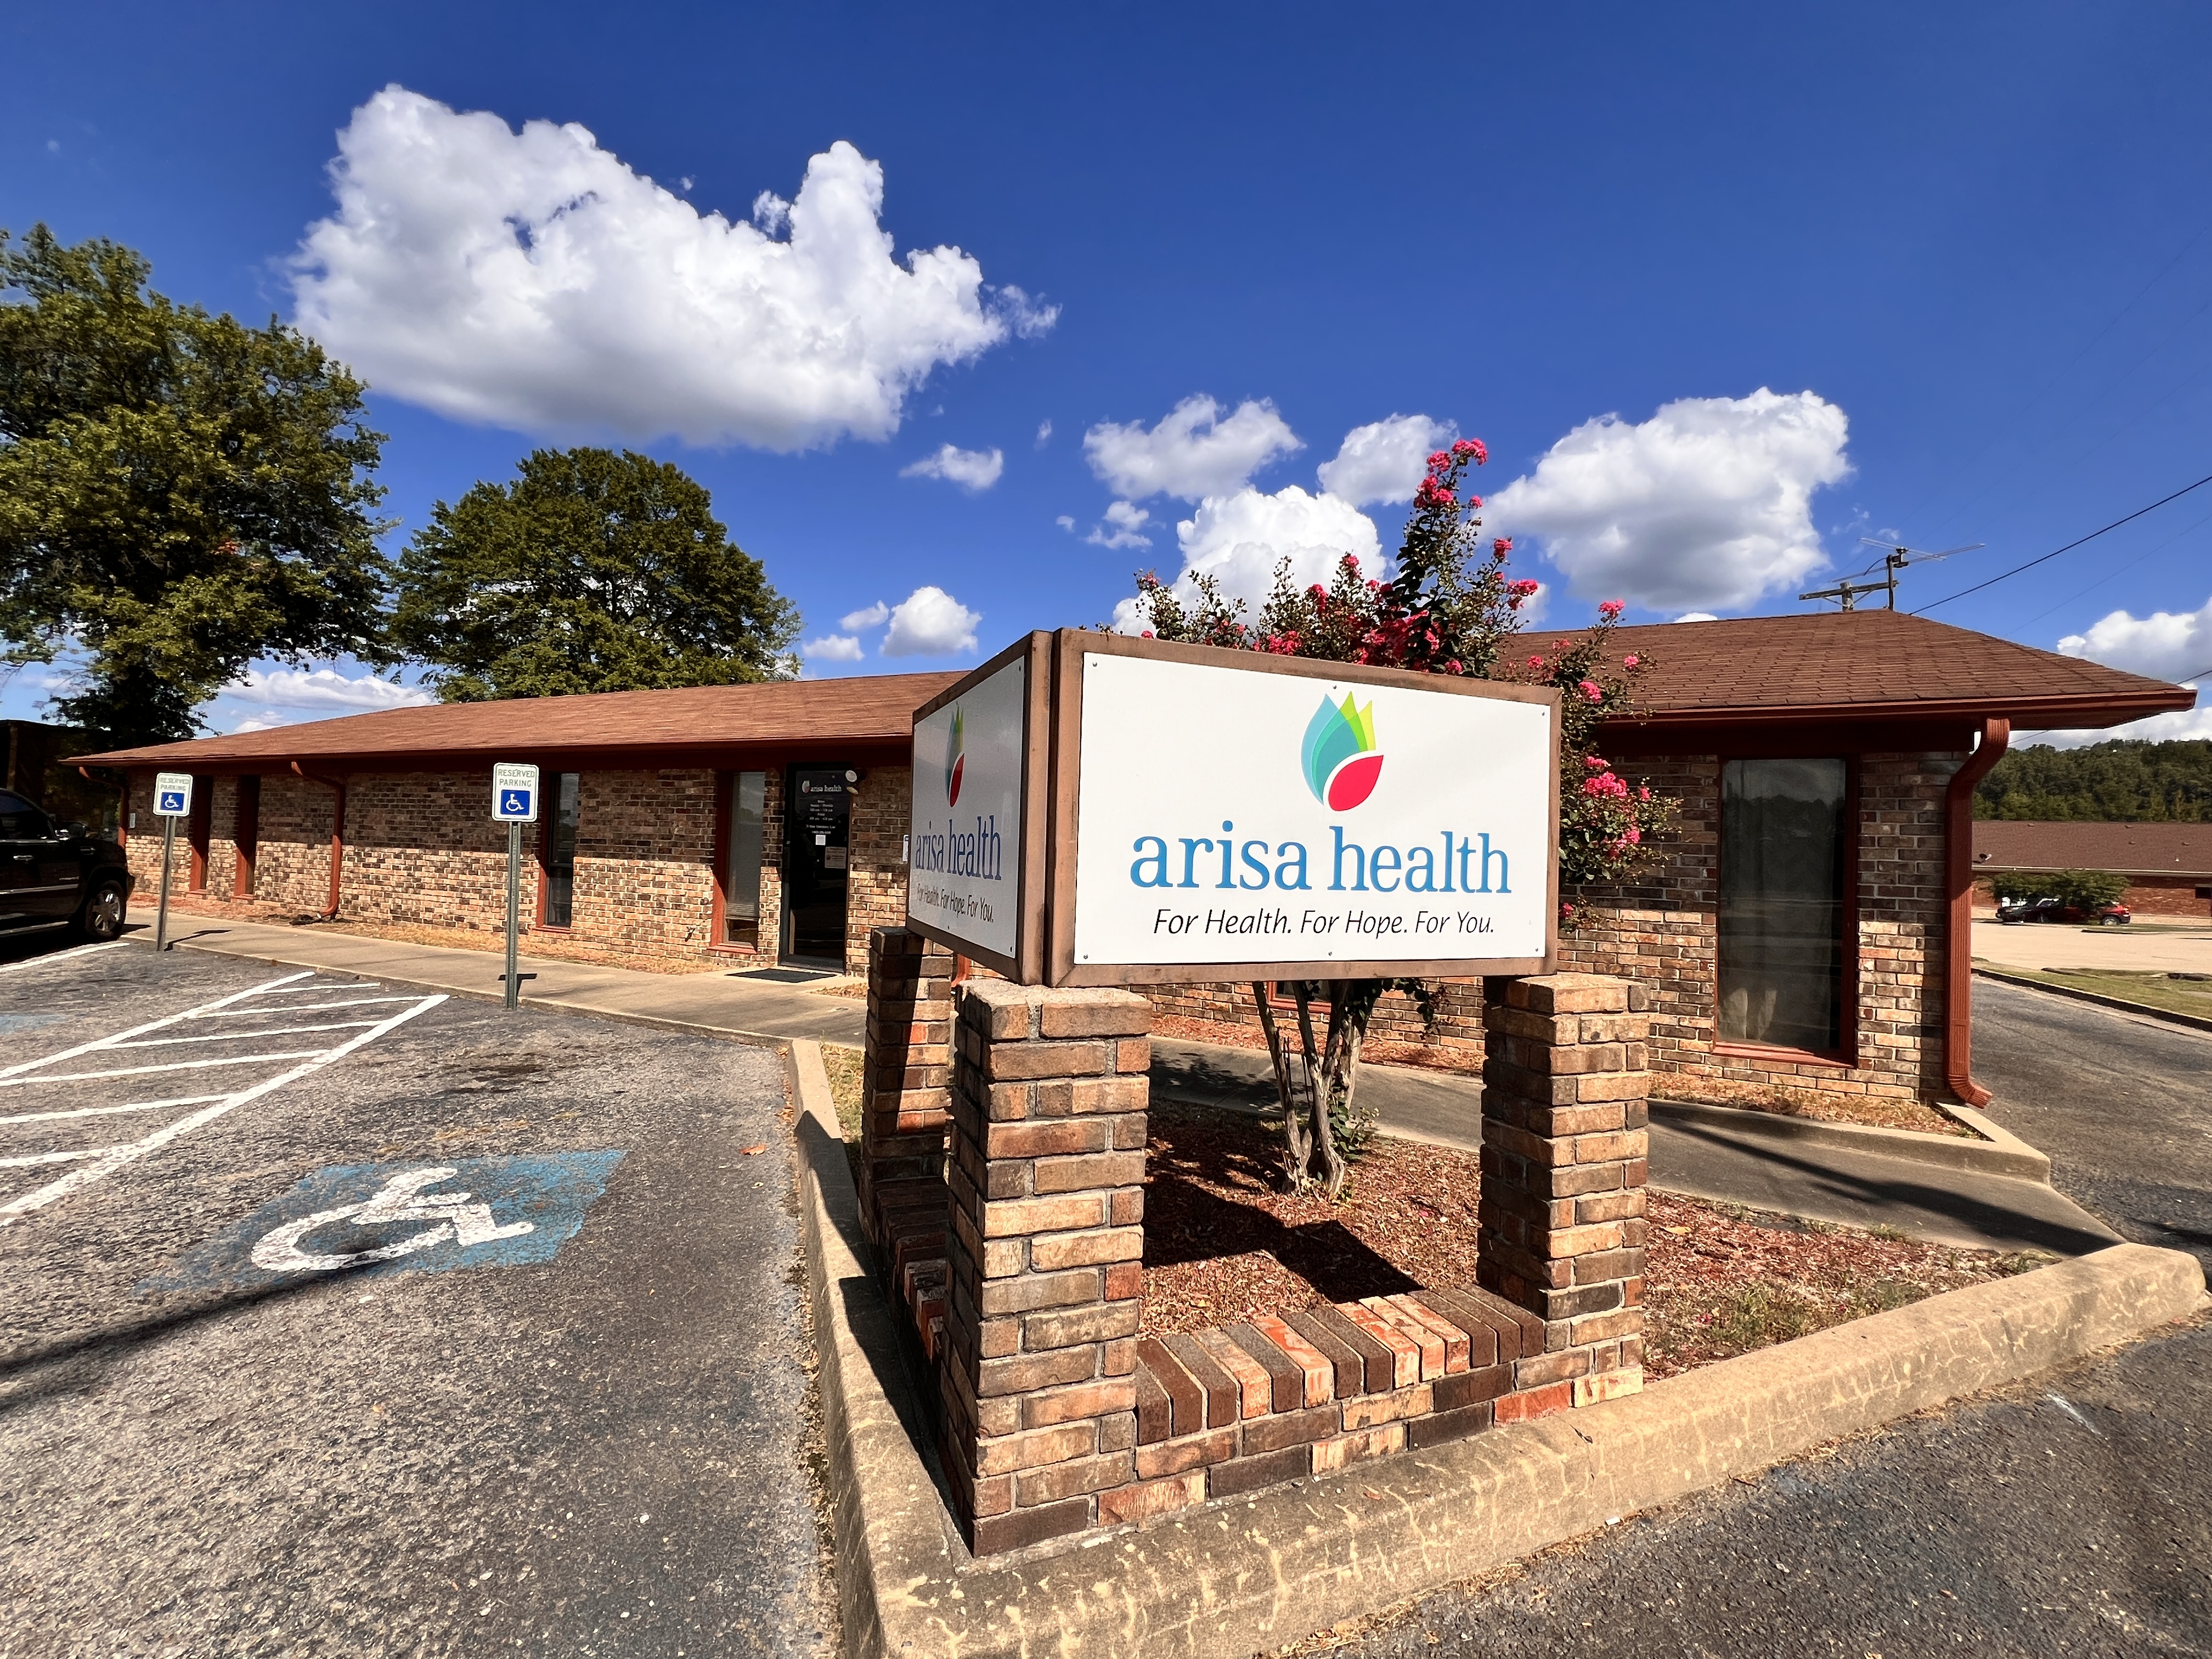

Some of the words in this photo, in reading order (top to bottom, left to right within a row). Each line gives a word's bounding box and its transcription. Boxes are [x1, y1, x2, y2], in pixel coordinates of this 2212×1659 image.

[498, 769, 535, 777] RESERVED
[499, 778, 532, 787] PARKING
[824, 784, 842, 792] health
[916, 820, 944, 873] arisa
[947, 815, 1002, 881] health
[1130, 820, 1312, 890] arisa
[1327, 825, 1512, 894] health
[941, 889, 950, 909] For
[950, 890, 966, 918] Hope.
[967, 894, 979, 918] For
[980, 896, 994, 923] You.
[1153, 909, 1199, 934] For
[1205, 907, 1291, 934] Health.
[1300, 910, 1340, 934] For
[1345, 910, 1408, 939] Hope.
[1415, 911, 1451, 934] For
[1457, 911, 1494, 934] You.
